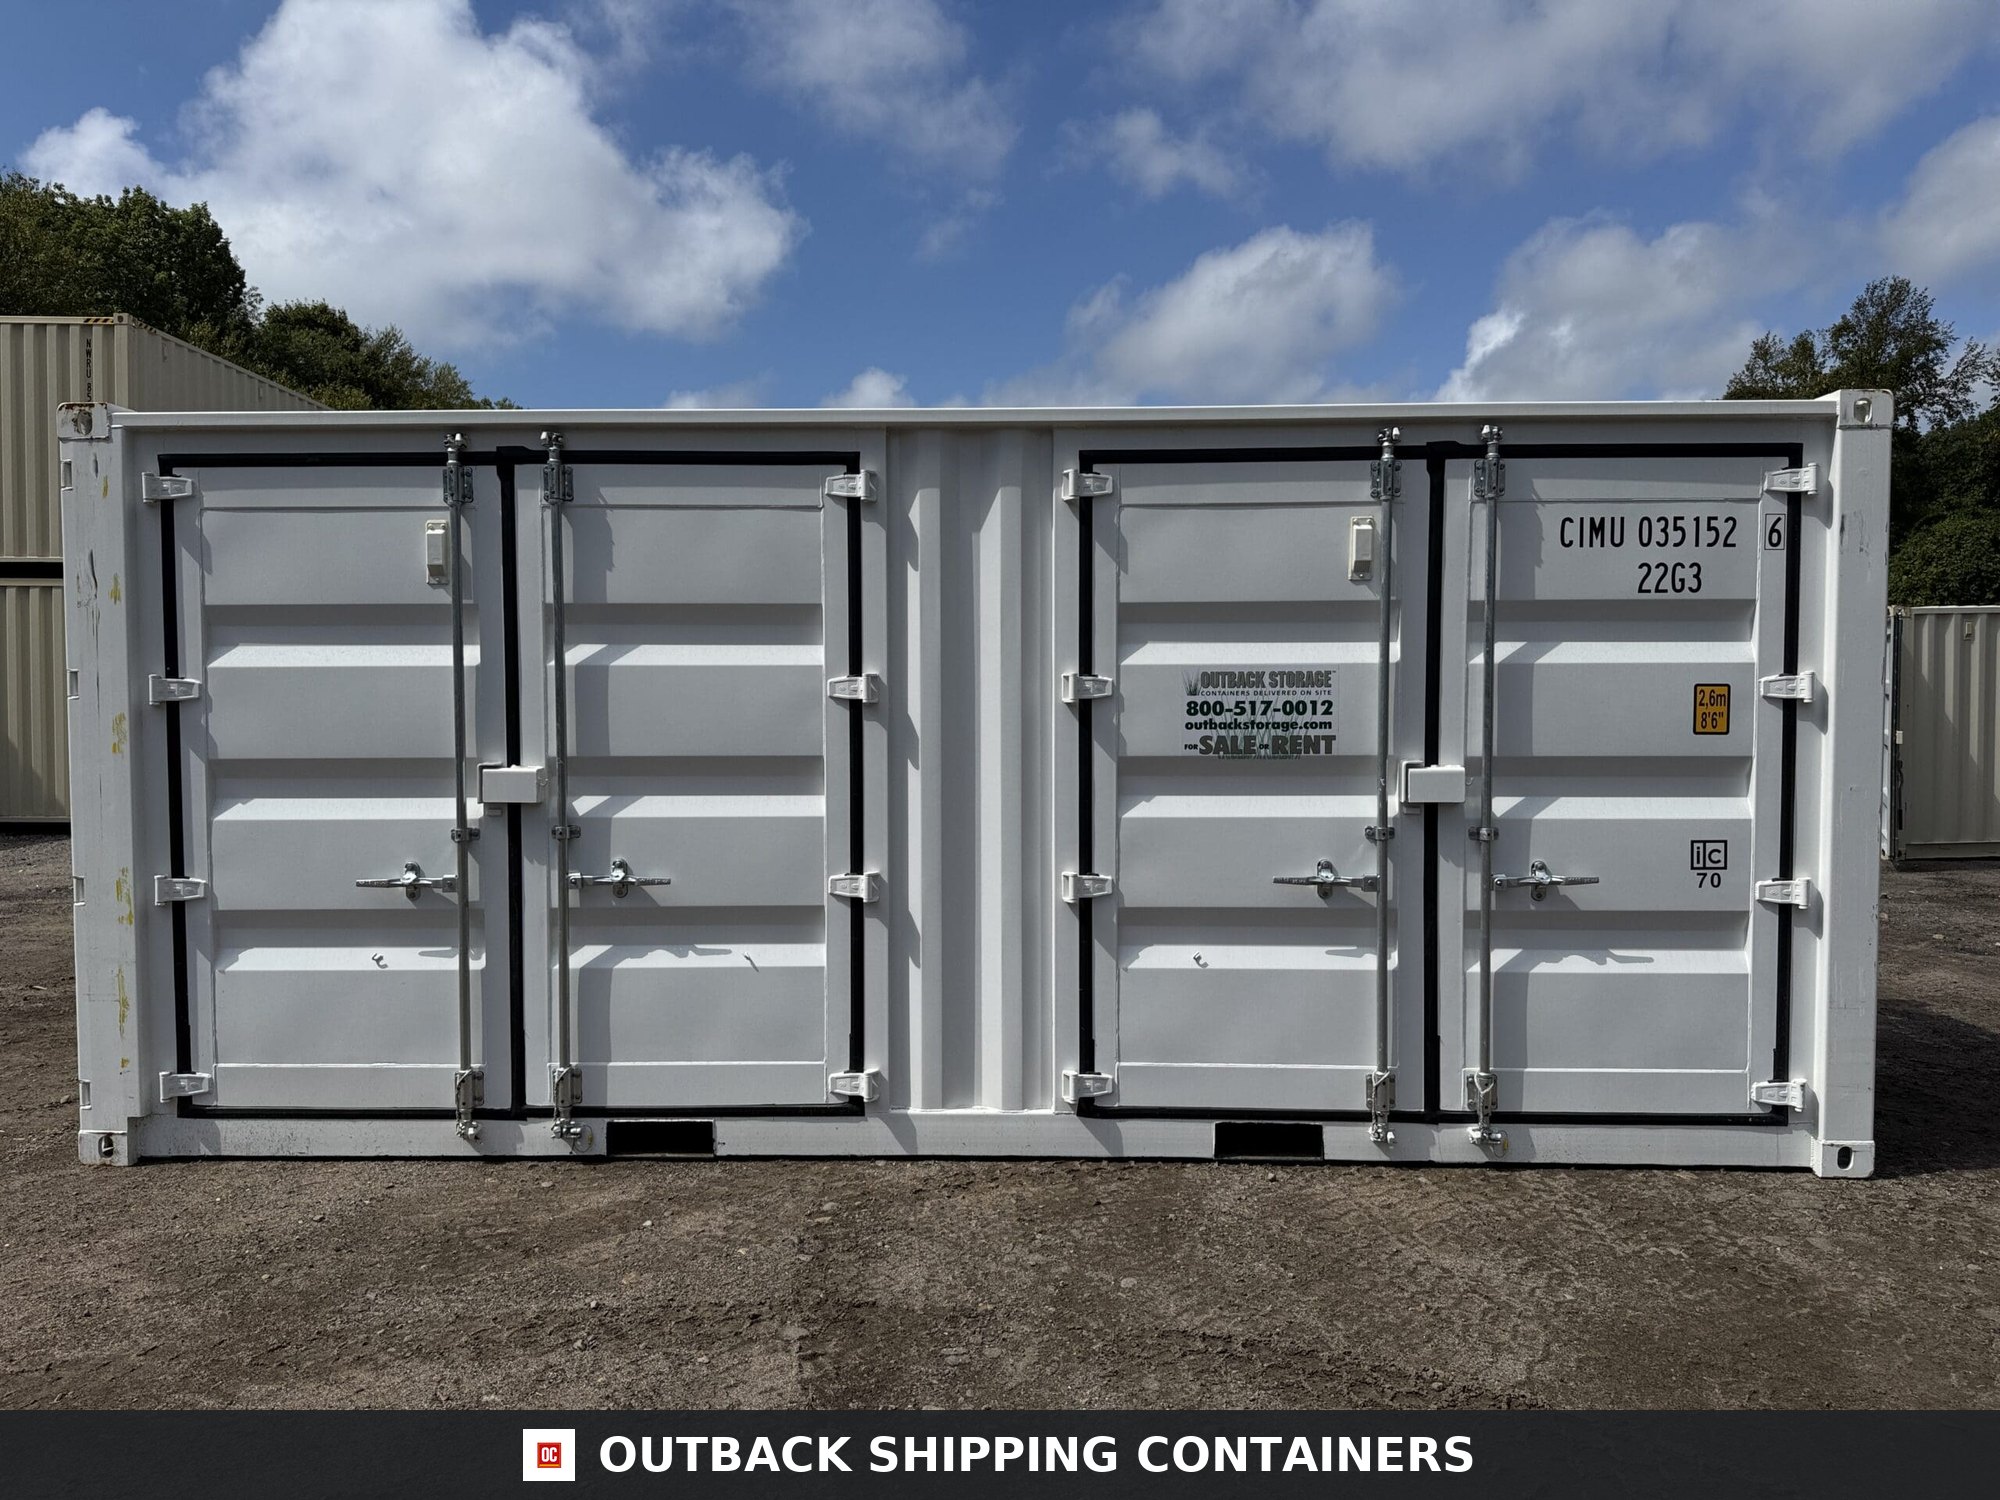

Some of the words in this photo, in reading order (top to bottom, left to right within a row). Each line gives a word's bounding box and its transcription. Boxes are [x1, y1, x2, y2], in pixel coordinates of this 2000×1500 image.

[1560, 516, 1626, 548] CIMU
[1638, 515, 1738, 548] 035152
[1767, 516, 1784, 548] 6
[1637, 562, 1703, 594] 22G3
[1200, 671, 1266, 689] OUTBACK
[1186, 700, 1333, 716] 800-517-0012
[1698, 689, 1727, 709] 2,6m
[1184, 718, 1332, 732] outbackstorage.com
[1700, 711, 1724, 730] 8'6"
[1198, 735, 1256, 755] SALE
[1271, 735, 1336, 755] RENT
[1696, 872, 1722, 889] 70
